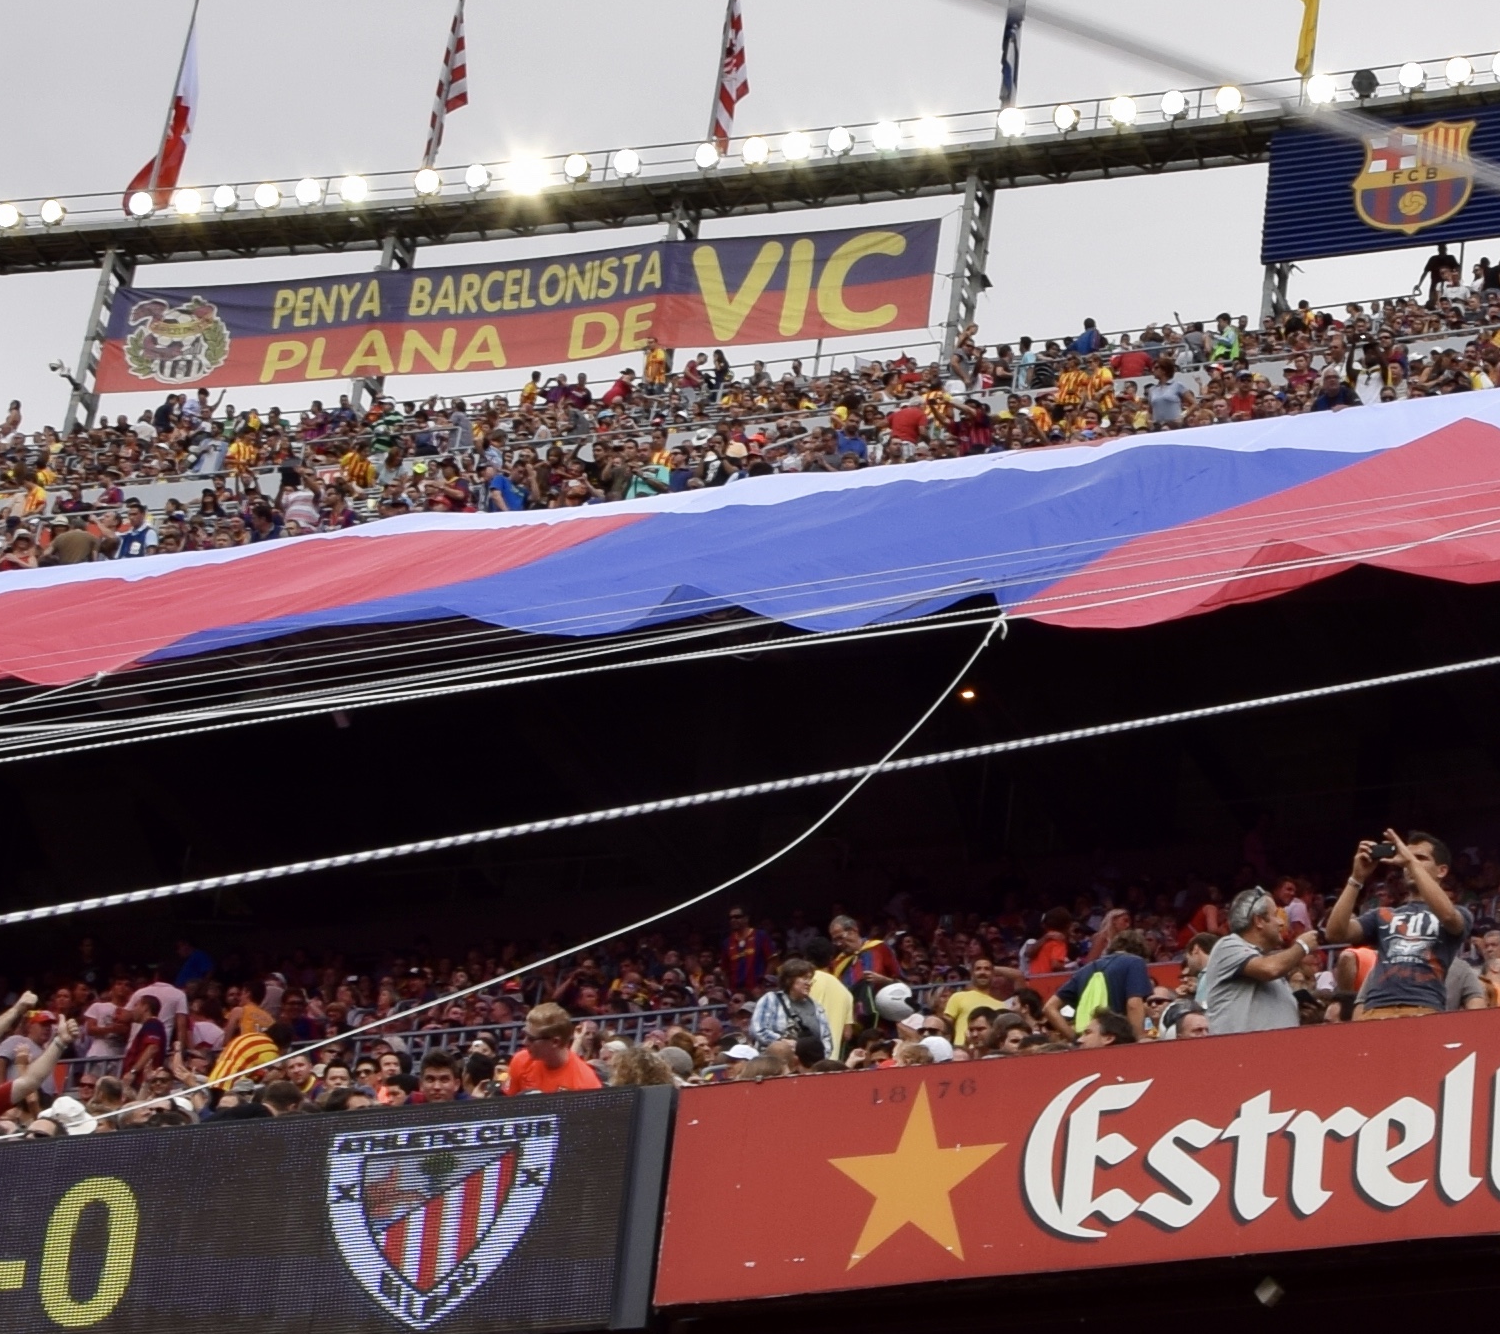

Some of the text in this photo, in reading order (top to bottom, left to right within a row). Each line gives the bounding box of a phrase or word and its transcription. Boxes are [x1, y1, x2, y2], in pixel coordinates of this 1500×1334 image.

[1391, 167, 1438, 185] FCB
[272, 249, 662, 330] PENYA BARCELONISTA
[691, 230, 907, 342] VIC
[258, 301, 657, 383] PLANA DE
